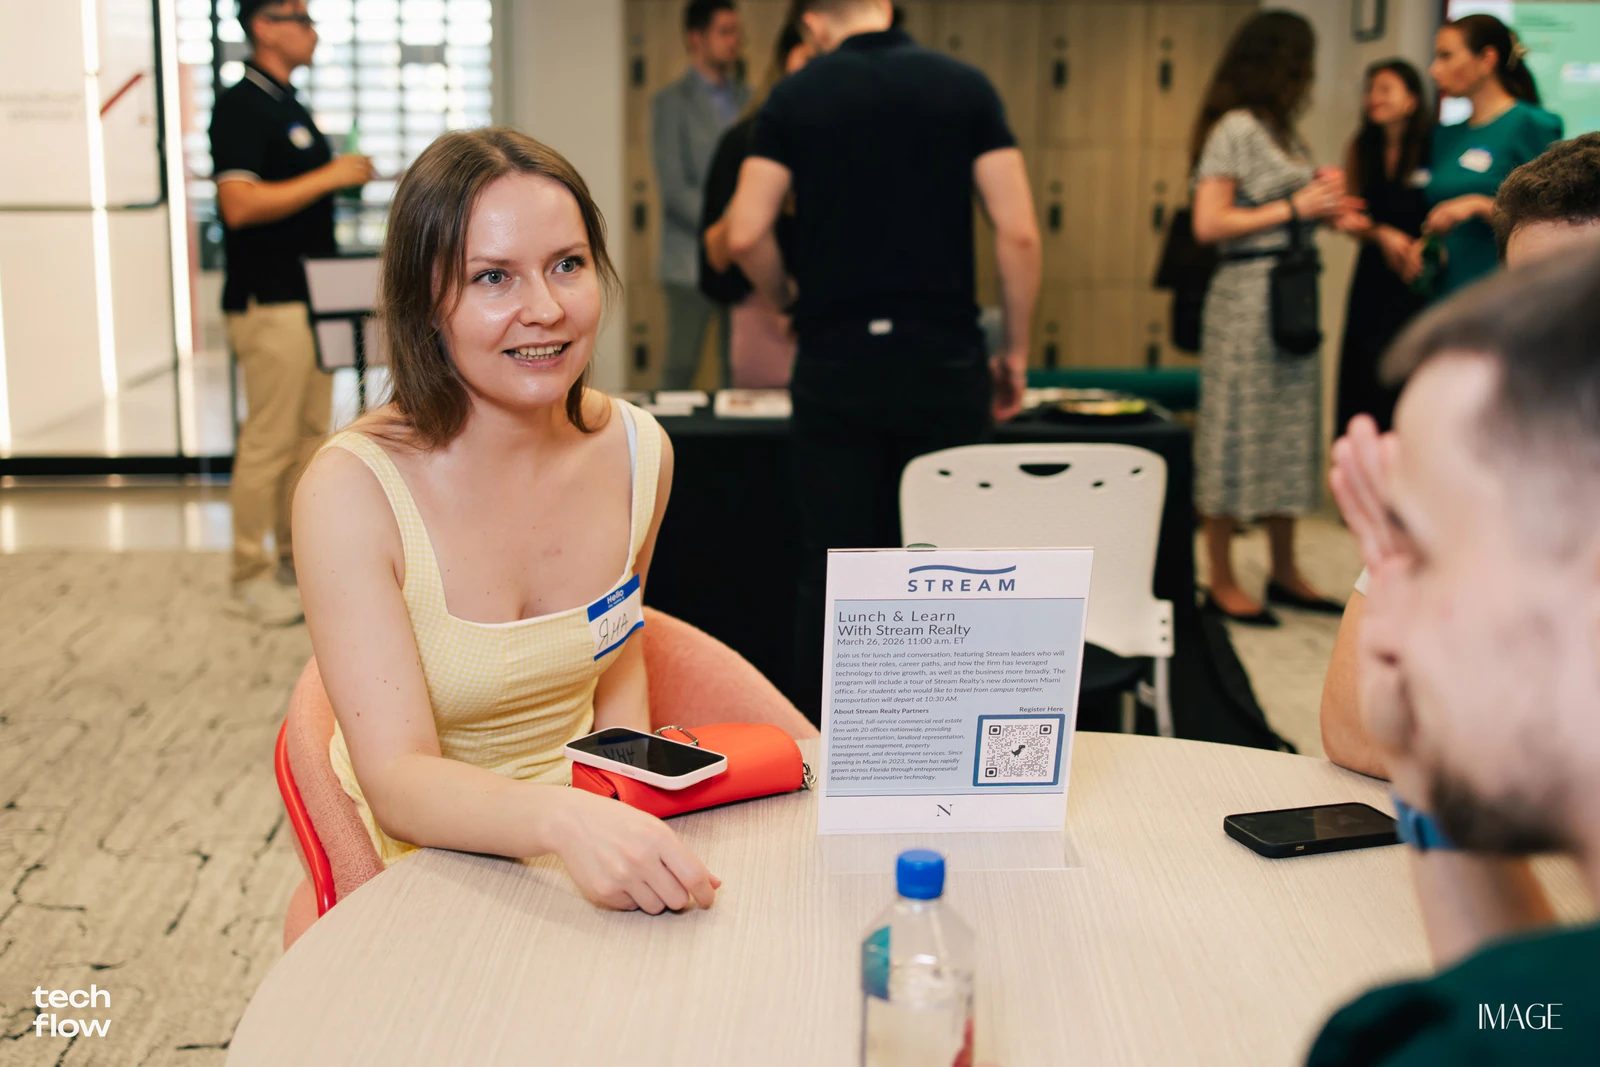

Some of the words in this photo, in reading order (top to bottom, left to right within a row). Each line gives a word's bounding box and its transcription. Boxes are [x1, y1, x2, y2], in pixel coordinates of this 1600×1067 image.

[908, 579, 1015, 592] STREAM
[606, 590, 624, 604] Hello
[839, 611, 886, 622] Lunch
[893, 611, 904, 622] &
[912, 611, 955, 622] Learn
[838, 625, 871, 636] With
[876, 625, 924, 636] Stream
[929, 624, 971, 637] Realty
[867, 638, 880, 646] 26,
[936, 804, 953, 817] N
